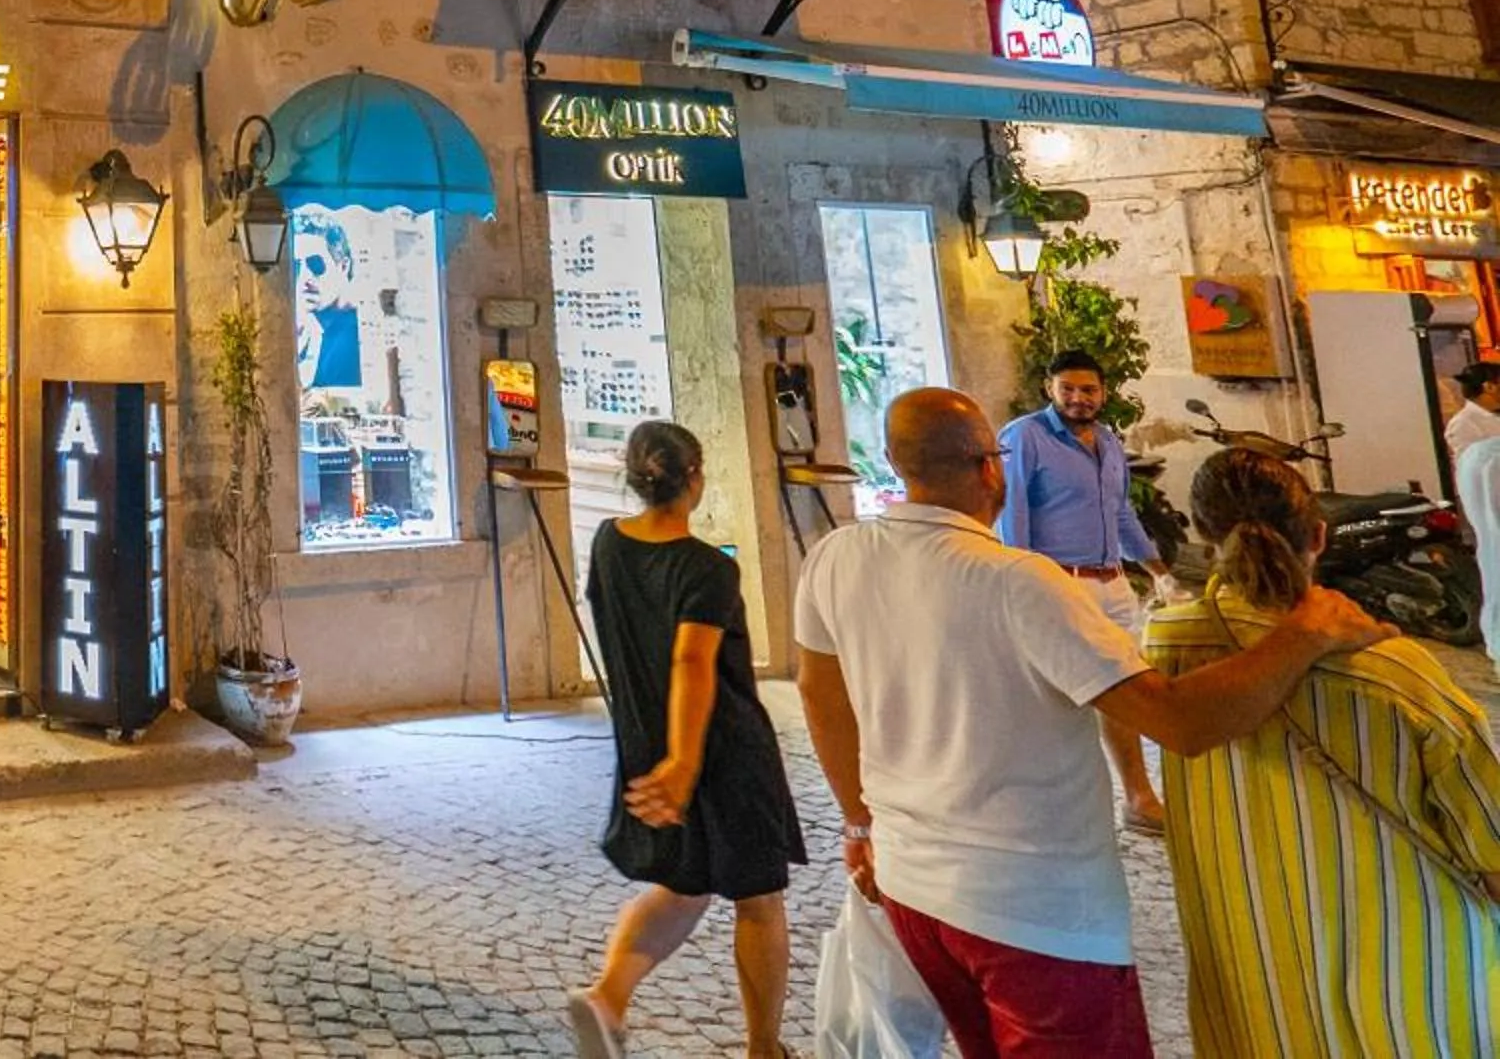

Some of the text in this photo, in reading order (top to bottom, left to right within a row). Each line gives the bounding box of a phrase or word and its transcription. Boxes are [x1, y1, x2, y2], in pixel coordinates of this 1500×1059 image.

[540, 93, 737, 138] 40MILLION
[1018, 91, 1119, 120] 40MILLION
[56, 401, 100, 699] ALTIN
[147, 402, 166, 698] ALTIN
